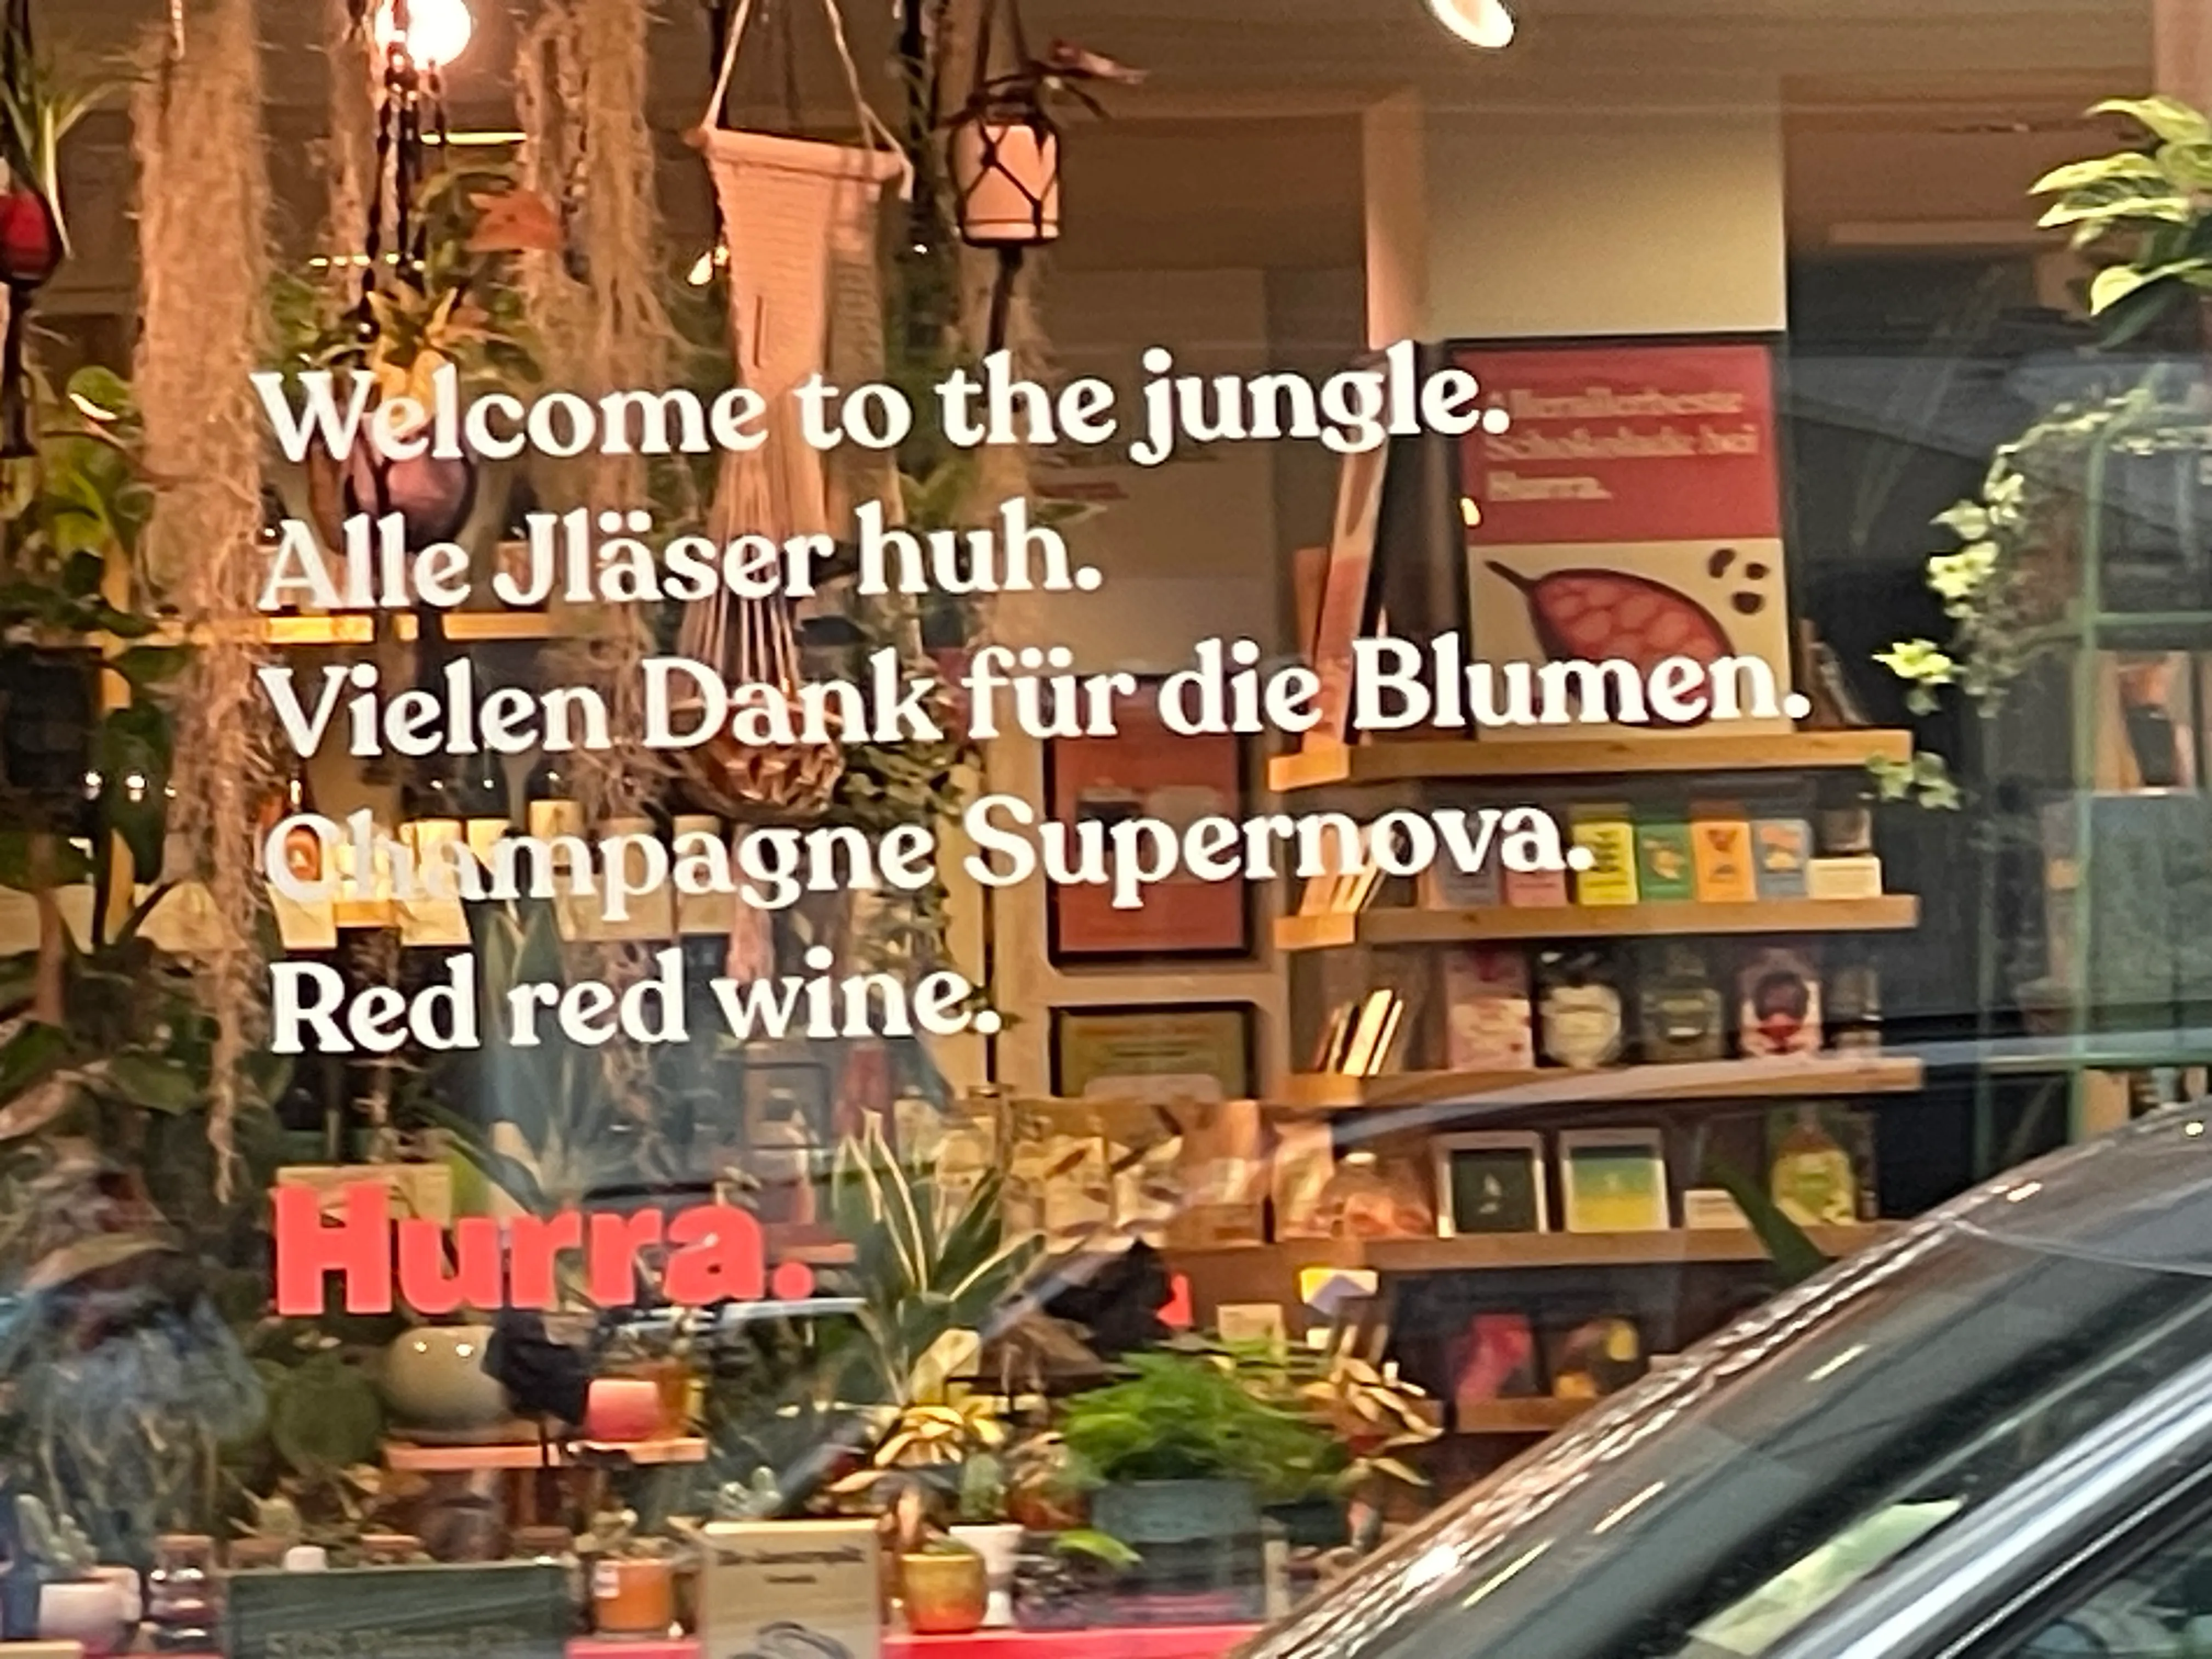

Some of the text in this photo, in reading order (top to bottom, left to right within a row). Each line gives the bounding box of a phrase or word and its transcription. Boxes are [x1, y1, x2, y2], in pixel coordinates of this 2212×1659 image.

[251, 341, 1511, 463] Welcome to the jungle.
[258, 496, 1102, 610] Alle Jläser huh.
[259, 632, 1810, 758] Vielen Dank für die Blumen.
[264, 809, 936, 921] Champagne
[962, 793, 1595, 907] Supernova.
[270, 945, 1002, 1053] Red red wine.
[274, 1181, 815, 1316] Hurra.
